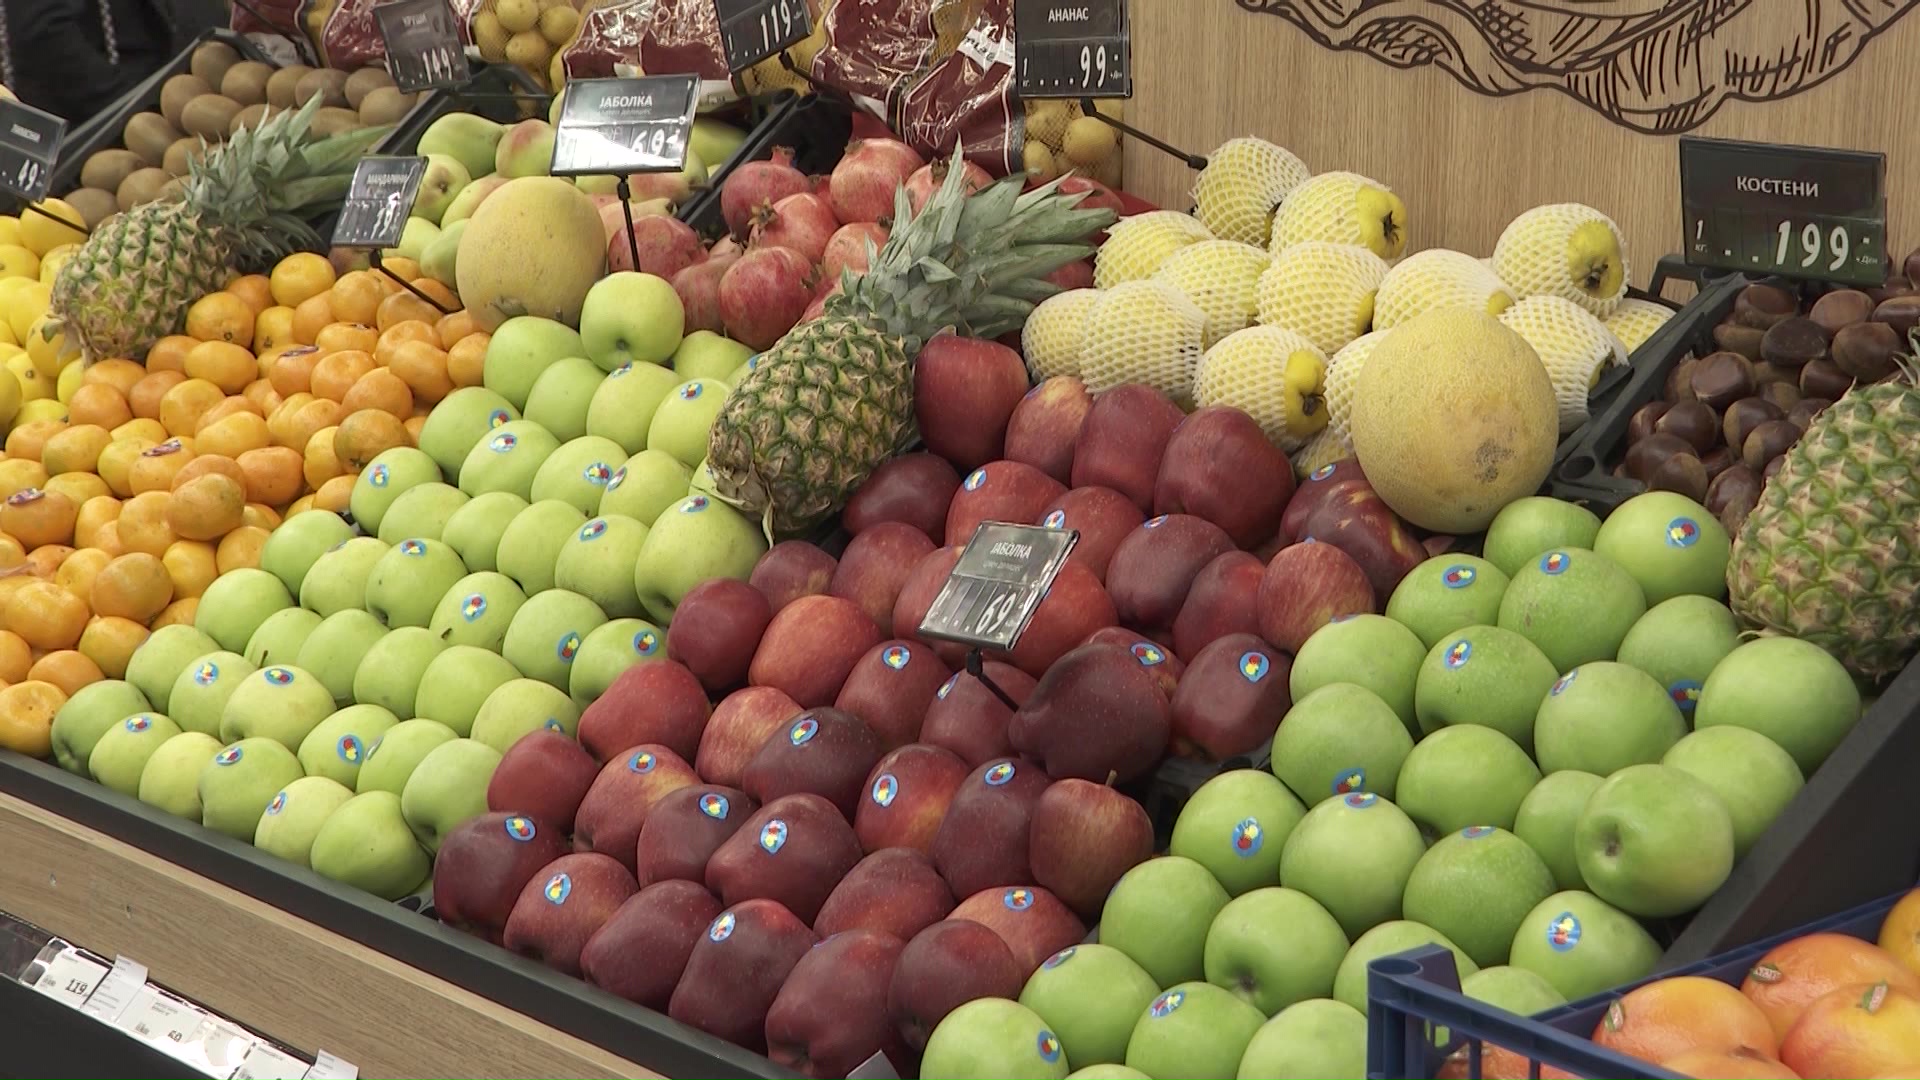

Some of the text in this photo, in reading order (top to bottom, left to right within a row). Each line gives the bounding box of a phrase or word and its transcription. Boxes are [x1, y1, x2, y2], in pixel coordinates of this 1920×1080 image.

[761, 0, 792, 53] 119
[1048, 7, 1089, 22] АНАНАС
[422, 47, 453, 84] 149
[1080, 45, 1107, 89] 99
[600, 95, 653, 109] ЈАБОЛКА
[1737, 175, 1819, 198] КОСТЕНИ
[1697, 220, 1849, 272] 1 199
[989, 541, 1032, 559] ЈАБОЛКА
[975, 593, 1017, 635] 69
